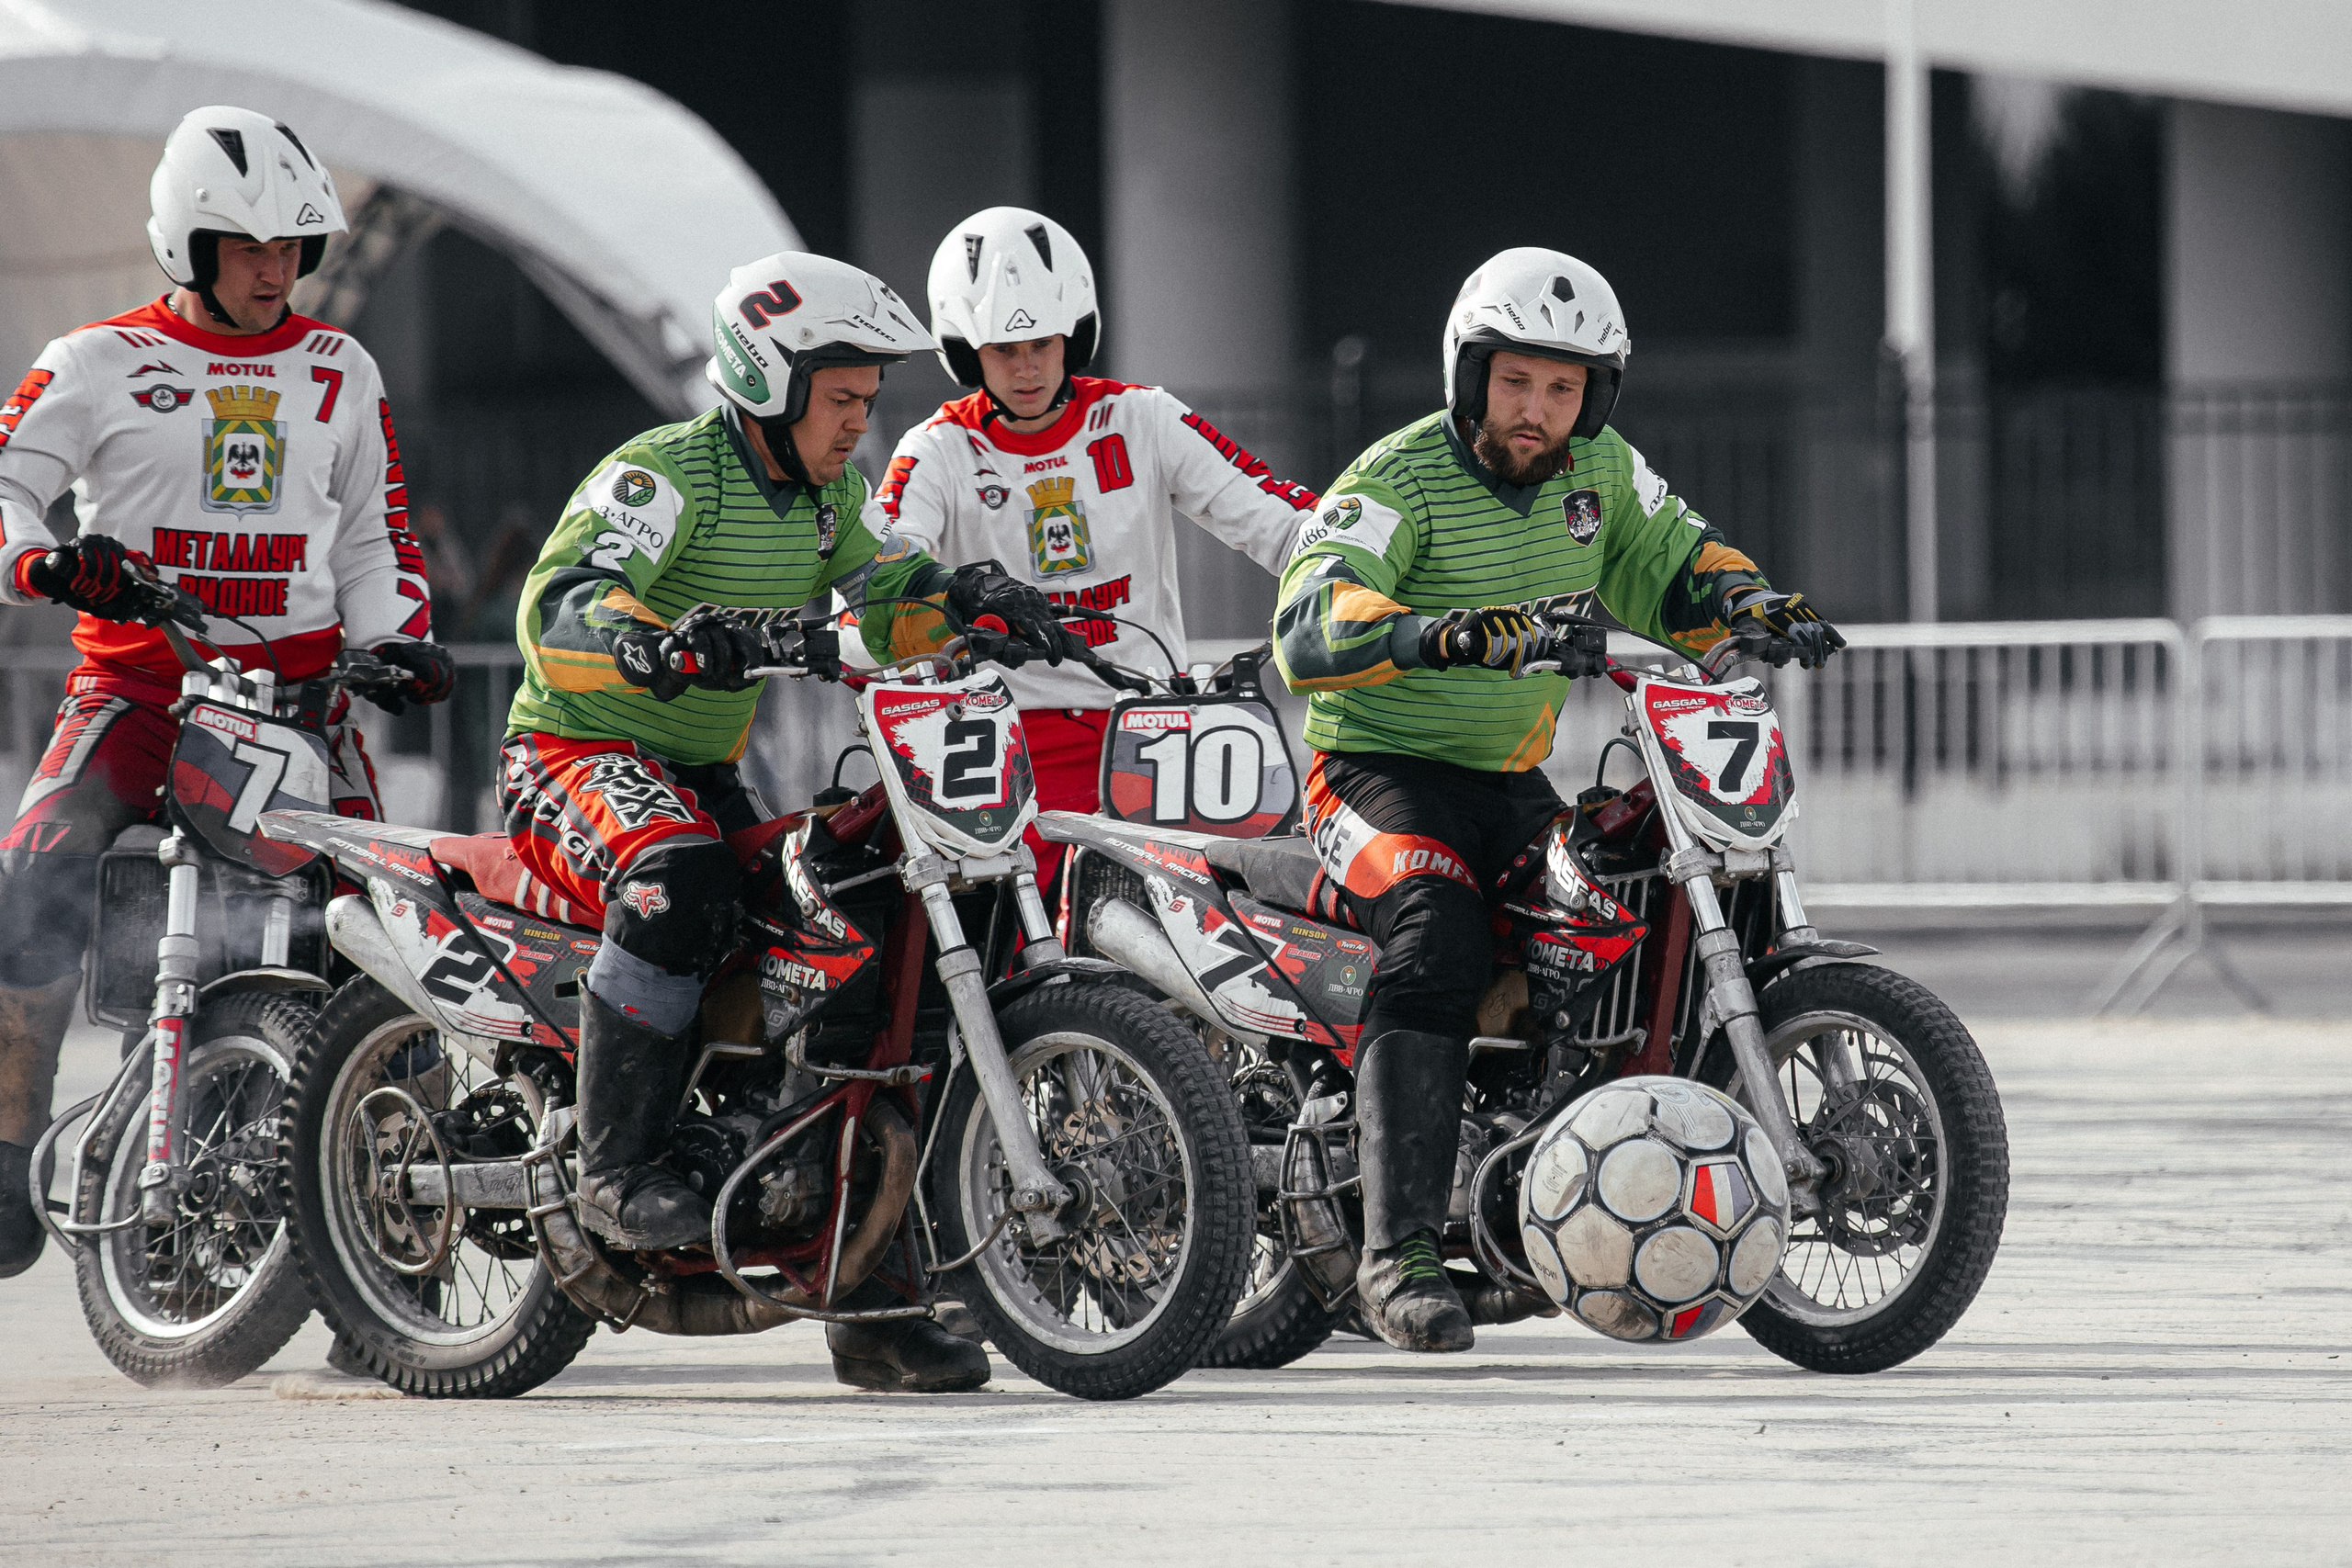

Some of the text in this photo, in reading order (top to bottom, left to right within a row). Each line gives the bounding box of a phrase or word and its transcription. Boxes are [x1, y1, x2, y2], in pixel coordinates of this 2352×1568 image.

[739, 279, 802, 330] 2
[730, 321, 769, 368] hebo
[853, 314, 897, 343] hebo
[206, 362, 277, 378] MOTUL
[311, 365, 345, 424] 7
[1023, 457, 1069, 474] MOTUL
[1086, 432, 1135, 494] 10
[153, 526, 309, 572] МЕТАЛЛУРГ
[198, 708, 254, 739] MOTUL
[881, 698, 941, 716] GASGAS
[1125, 713, 1190, 728] MOTUL
[1653, 698, 1707, 709] GASGAS
[942, 718, 997, 799] 2
[1137, 726, 1262, 824] 10
[1707, 721, 1759, 793] 7
[228, 739, 290, 835] 7
[326, 837, 434, 886] MOTOBALL RACING
[1103, 837, 1211, 886] MOTOBALL RACING
[483, 916, 513, 930] MOTUL
[524, 928, 561, 942] HINSON
[1252, 914, 1282, 927] MOTUL
[1292, 927, 1328, 941] HINSON
[418, 930, 515, 1010] 2
[1197, 926, 1282, 993] 7
